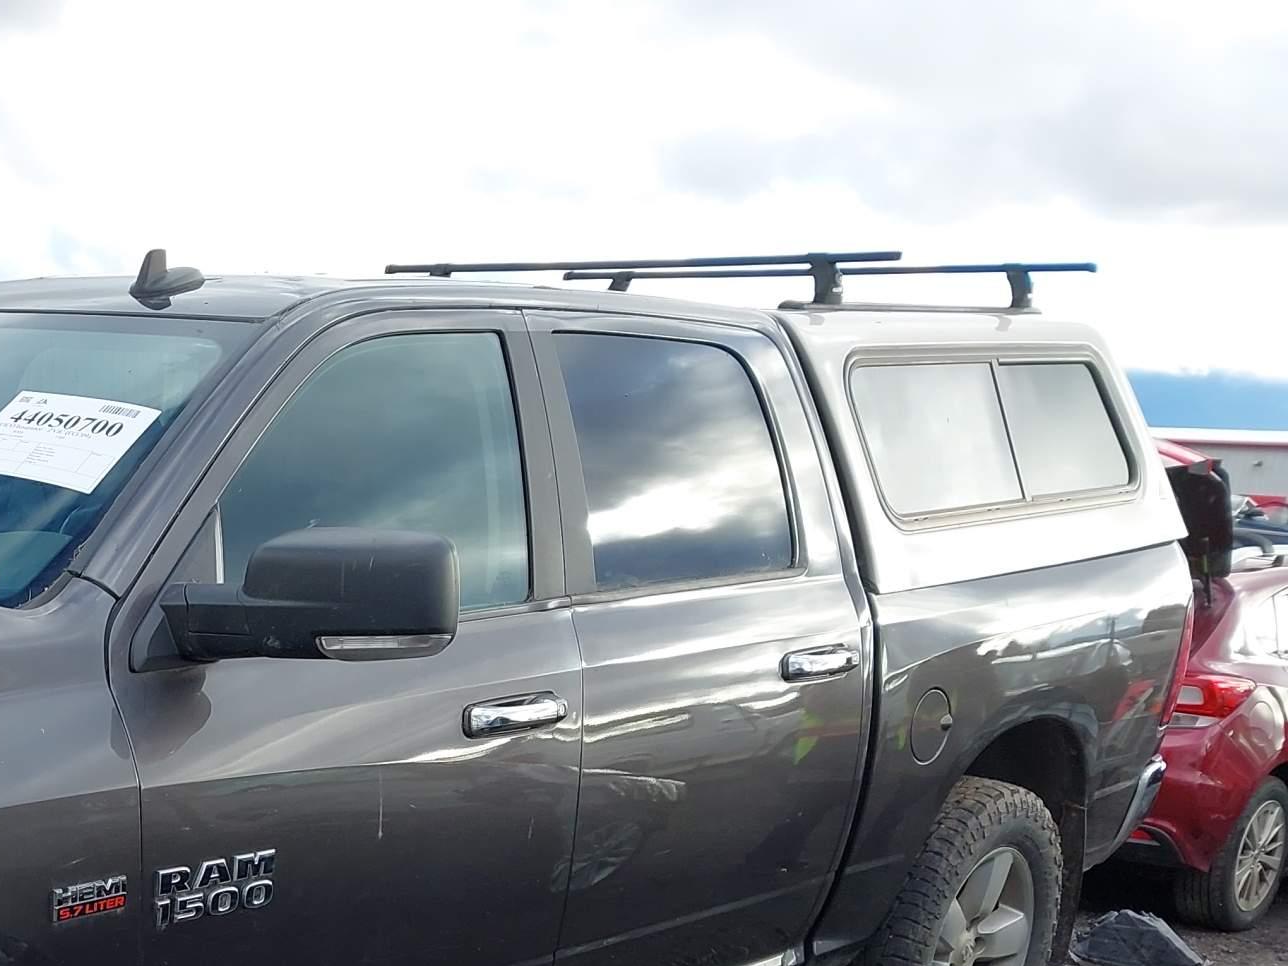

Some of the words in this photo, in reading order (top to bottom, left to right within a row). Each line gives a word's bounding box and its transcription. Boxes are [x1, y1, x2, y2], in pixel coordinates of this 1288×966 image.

[10, 409, 123, 438] 44050700
[155, 849, 276, 897] RAM
[53, 875, 127, 907] HEMI
[155, 879, 274, 930] 1500
[59, 905, 83, 921] 5.7
[84, 896, 125, 914] LITER
